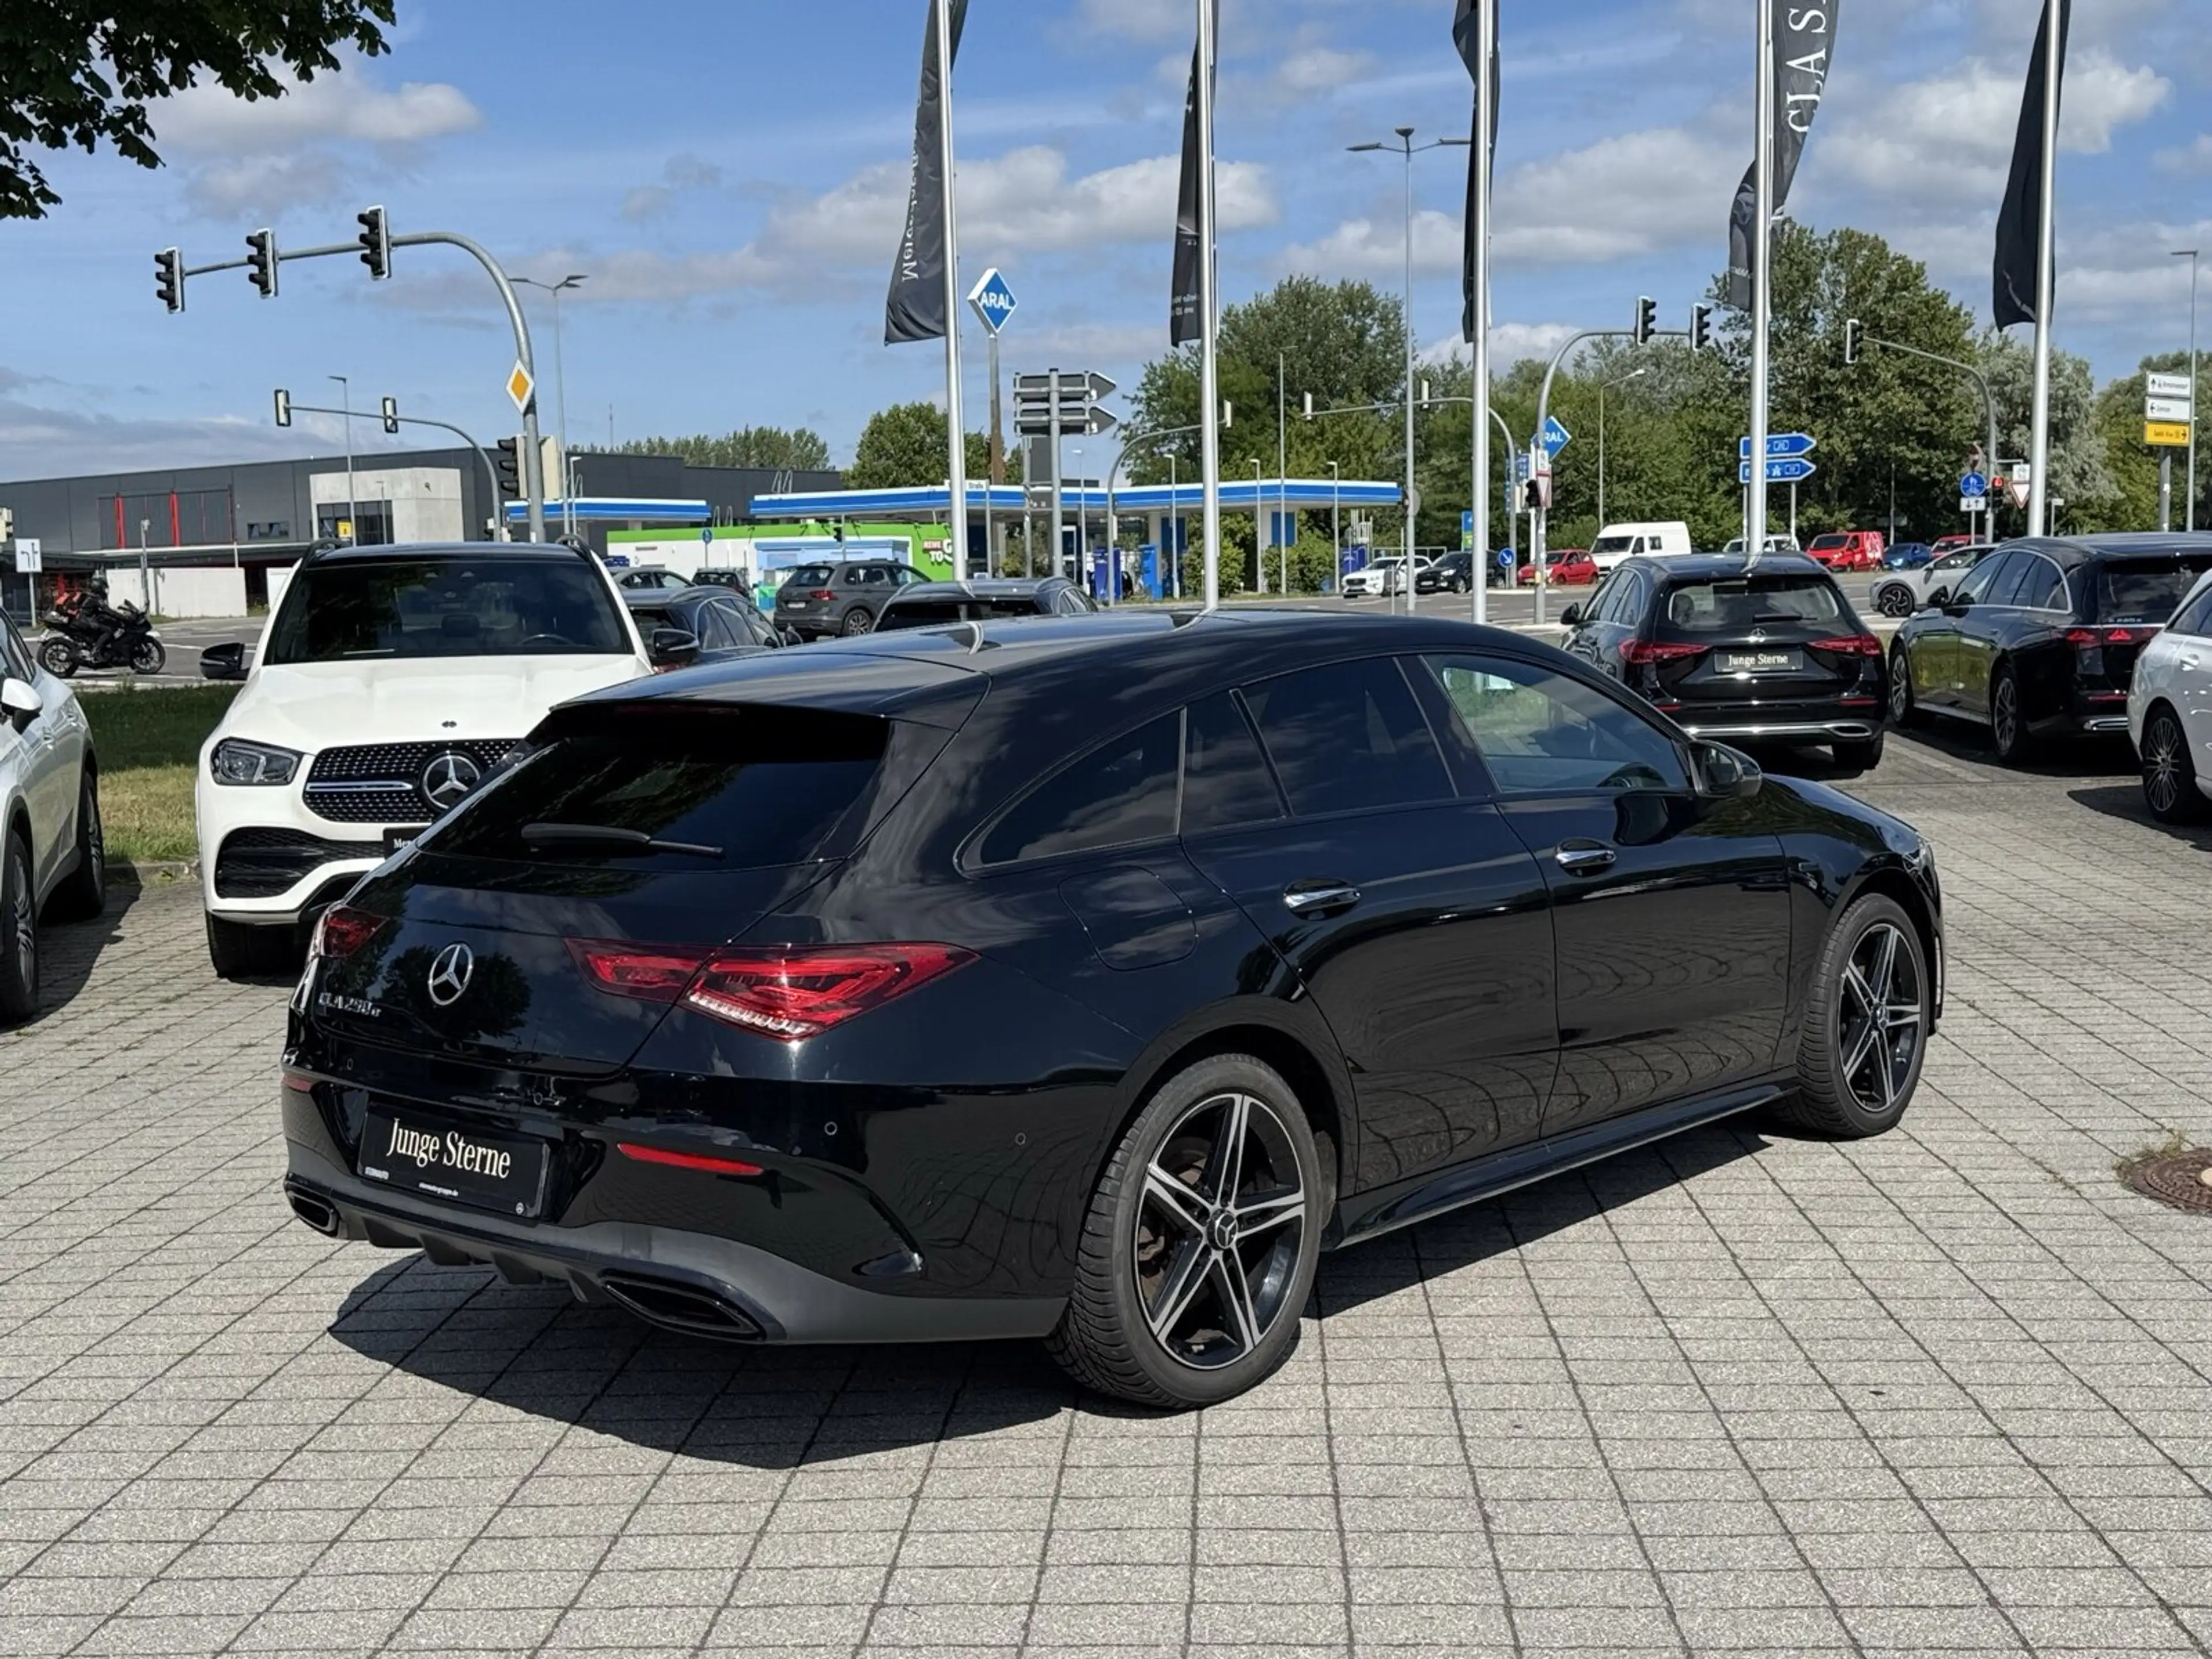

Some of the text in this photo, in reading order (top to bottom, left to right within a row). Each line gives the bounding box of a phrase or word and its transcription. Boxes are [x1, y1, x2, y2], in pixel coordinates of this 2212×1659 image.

[980, 291, 1014, 310] ARAL
[1545, 431, 1564, 443] RAL
[929, 551, 944, 562] TO
[1729, 653, 1788, 668] Junge Sterne
[385, 1117, 512, 1179] Junge Sterne
